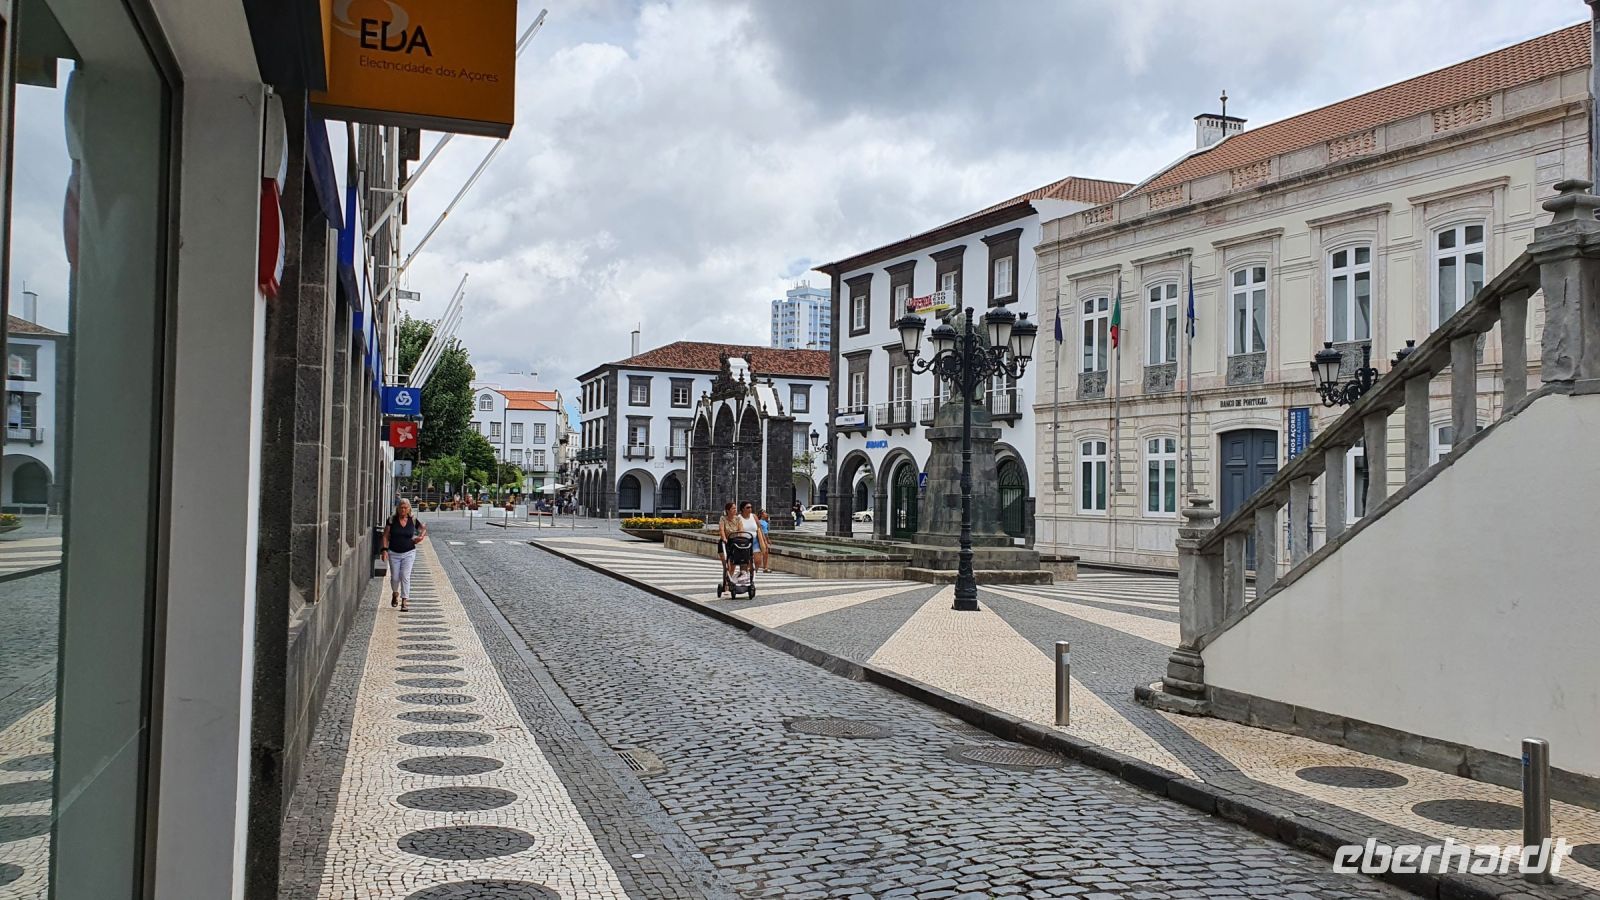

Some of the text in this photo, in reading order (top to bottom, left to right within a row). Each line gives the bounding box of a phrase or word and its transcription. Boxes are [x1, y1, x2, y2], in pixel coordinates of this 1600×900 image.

[360, 18, 432, 57] EDA
[359, 55, 499, 83] Electricidade dos Açores
[1243, 398, 1268, 406] PORTUGAL
